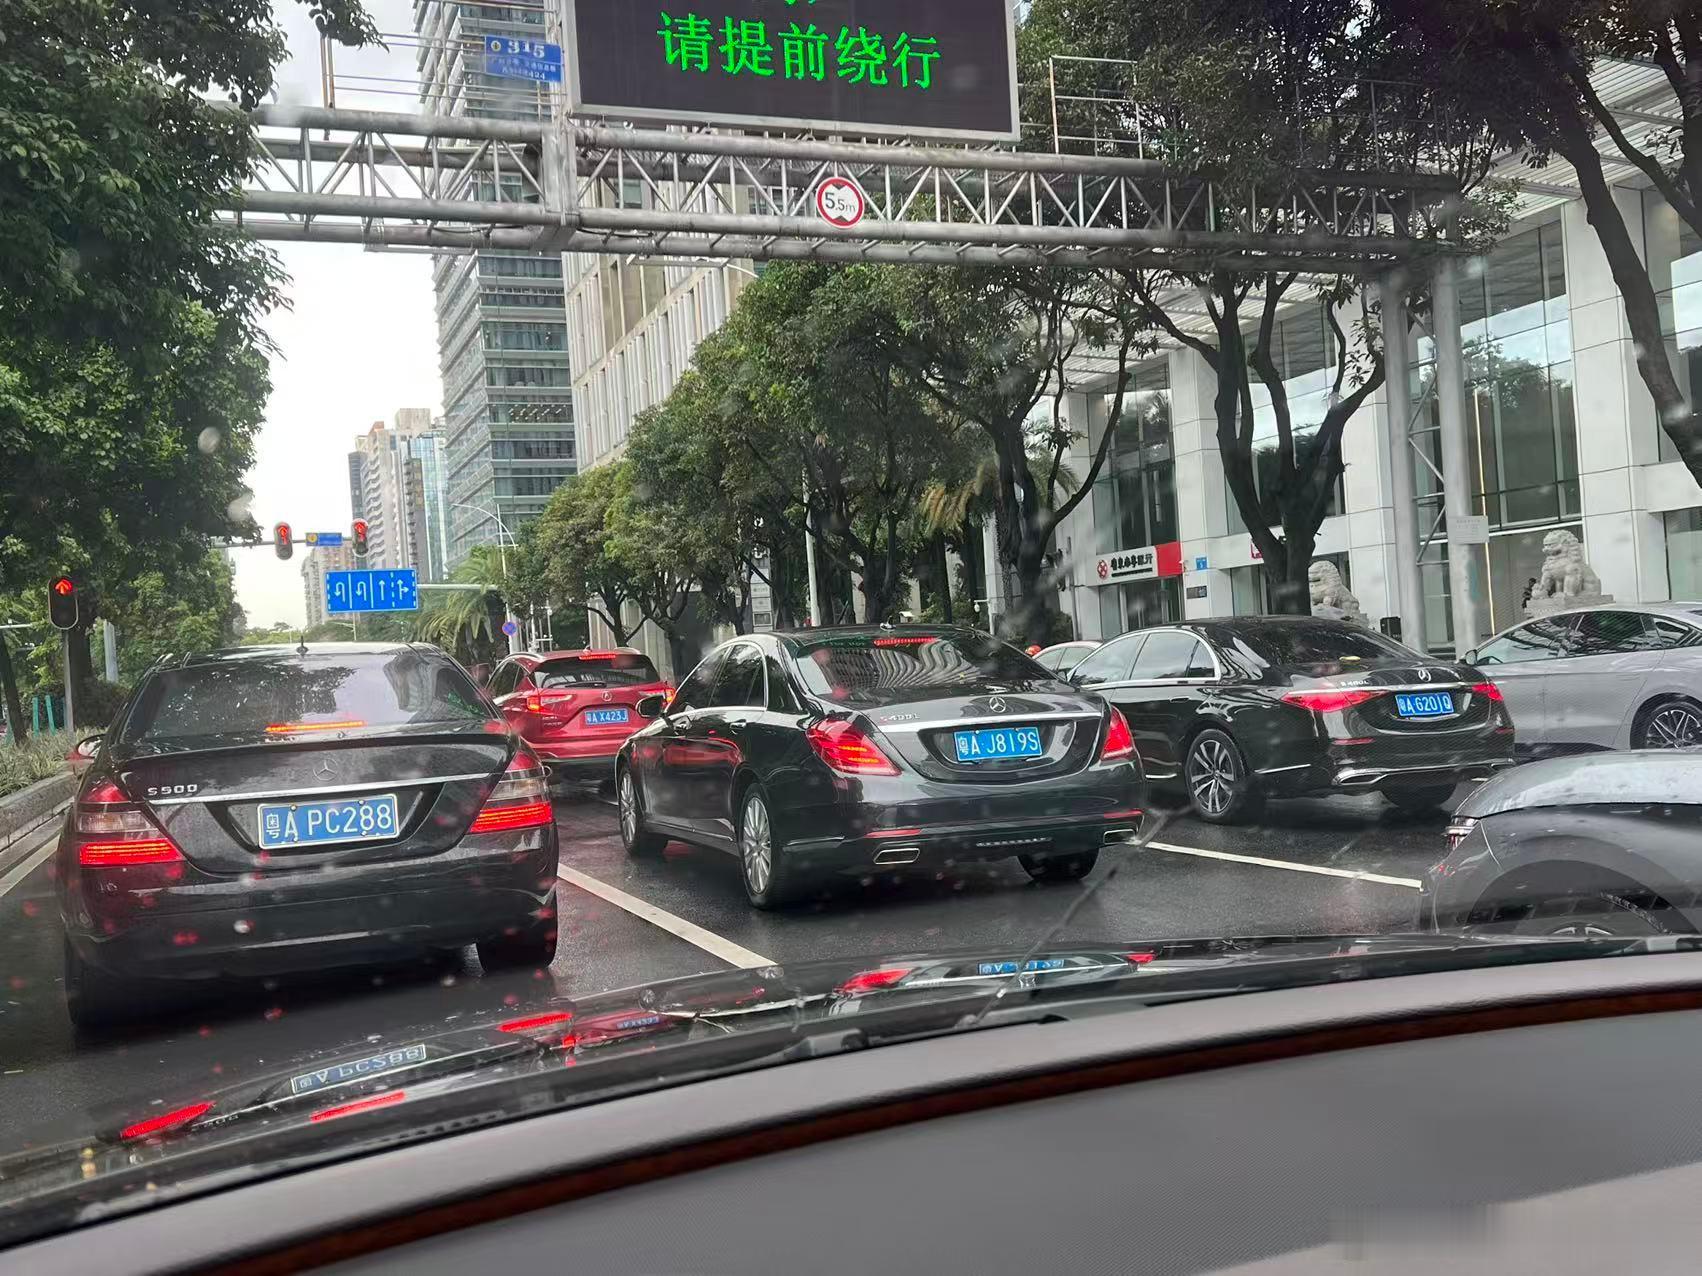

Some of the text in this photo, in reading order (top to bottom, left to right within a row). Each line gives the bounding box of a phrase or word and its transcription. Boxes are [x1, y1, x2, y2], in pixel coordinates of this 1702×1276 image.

[507, 40, 545, 59] 315
[656, 11, 941, 89] 请提前绕行
[825, 191, 856, 213] 5.5m
[147, 783, 198, 796] S500
